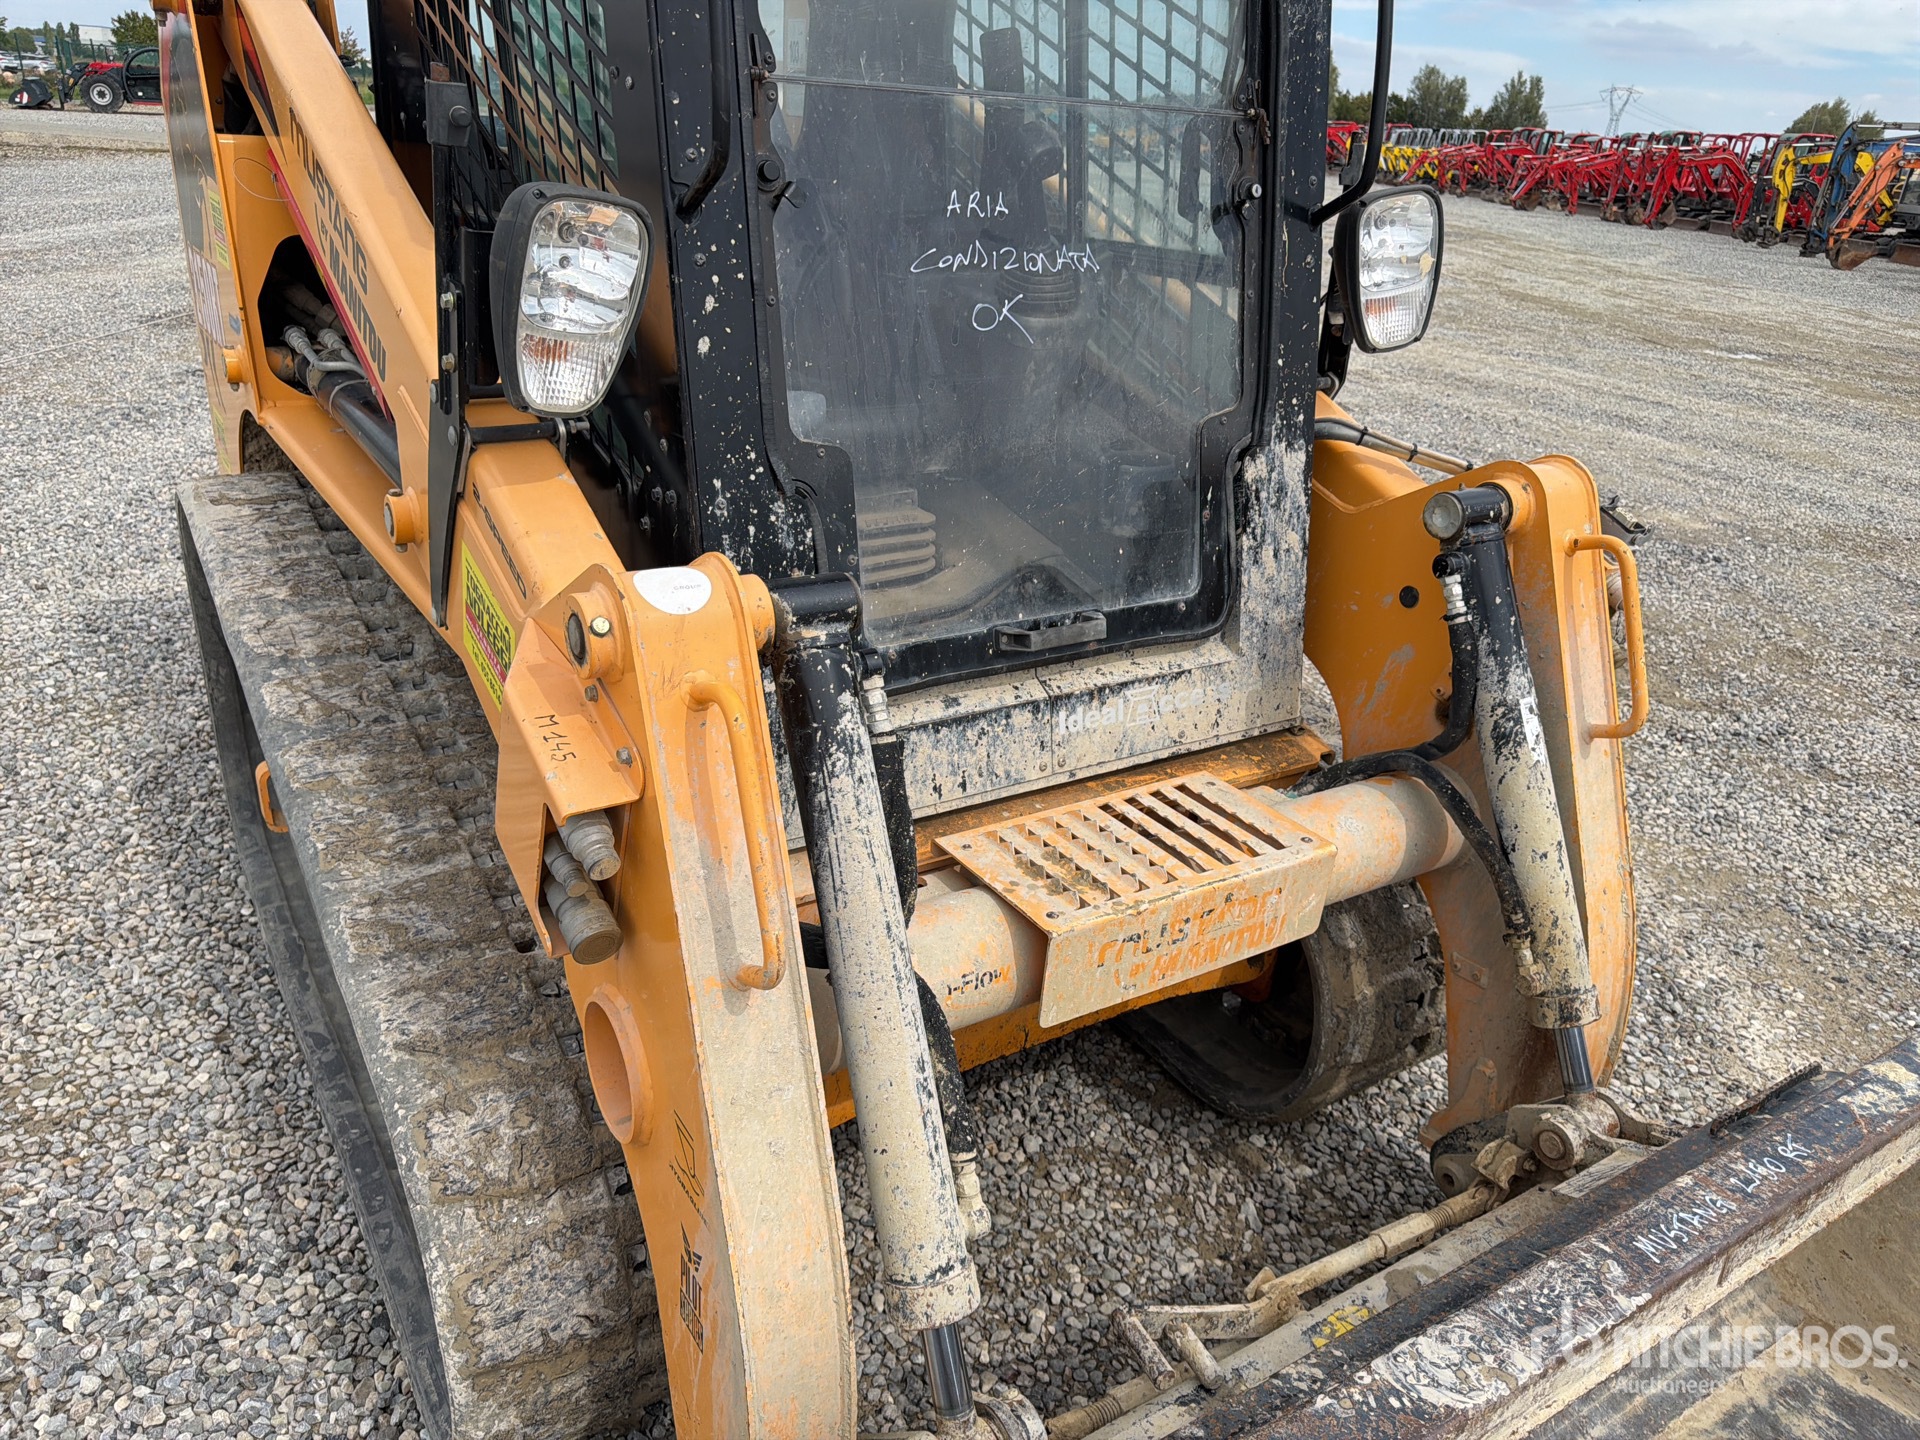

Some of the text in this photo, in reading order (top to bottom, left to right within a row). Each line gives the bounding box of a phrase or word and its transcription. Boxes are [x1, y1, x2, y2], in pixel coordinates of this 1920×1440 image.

[289, 107, 368, 296] MUSTANG
[947, 189, 1008, 217] ARIA
[329, 234, 387, 383] MANITOU
[972, 294, 1034, 344] OK
[1058, 697, 1124, 735] Ideal
[1633, 1195, 1736, 1264] MUSTANG
